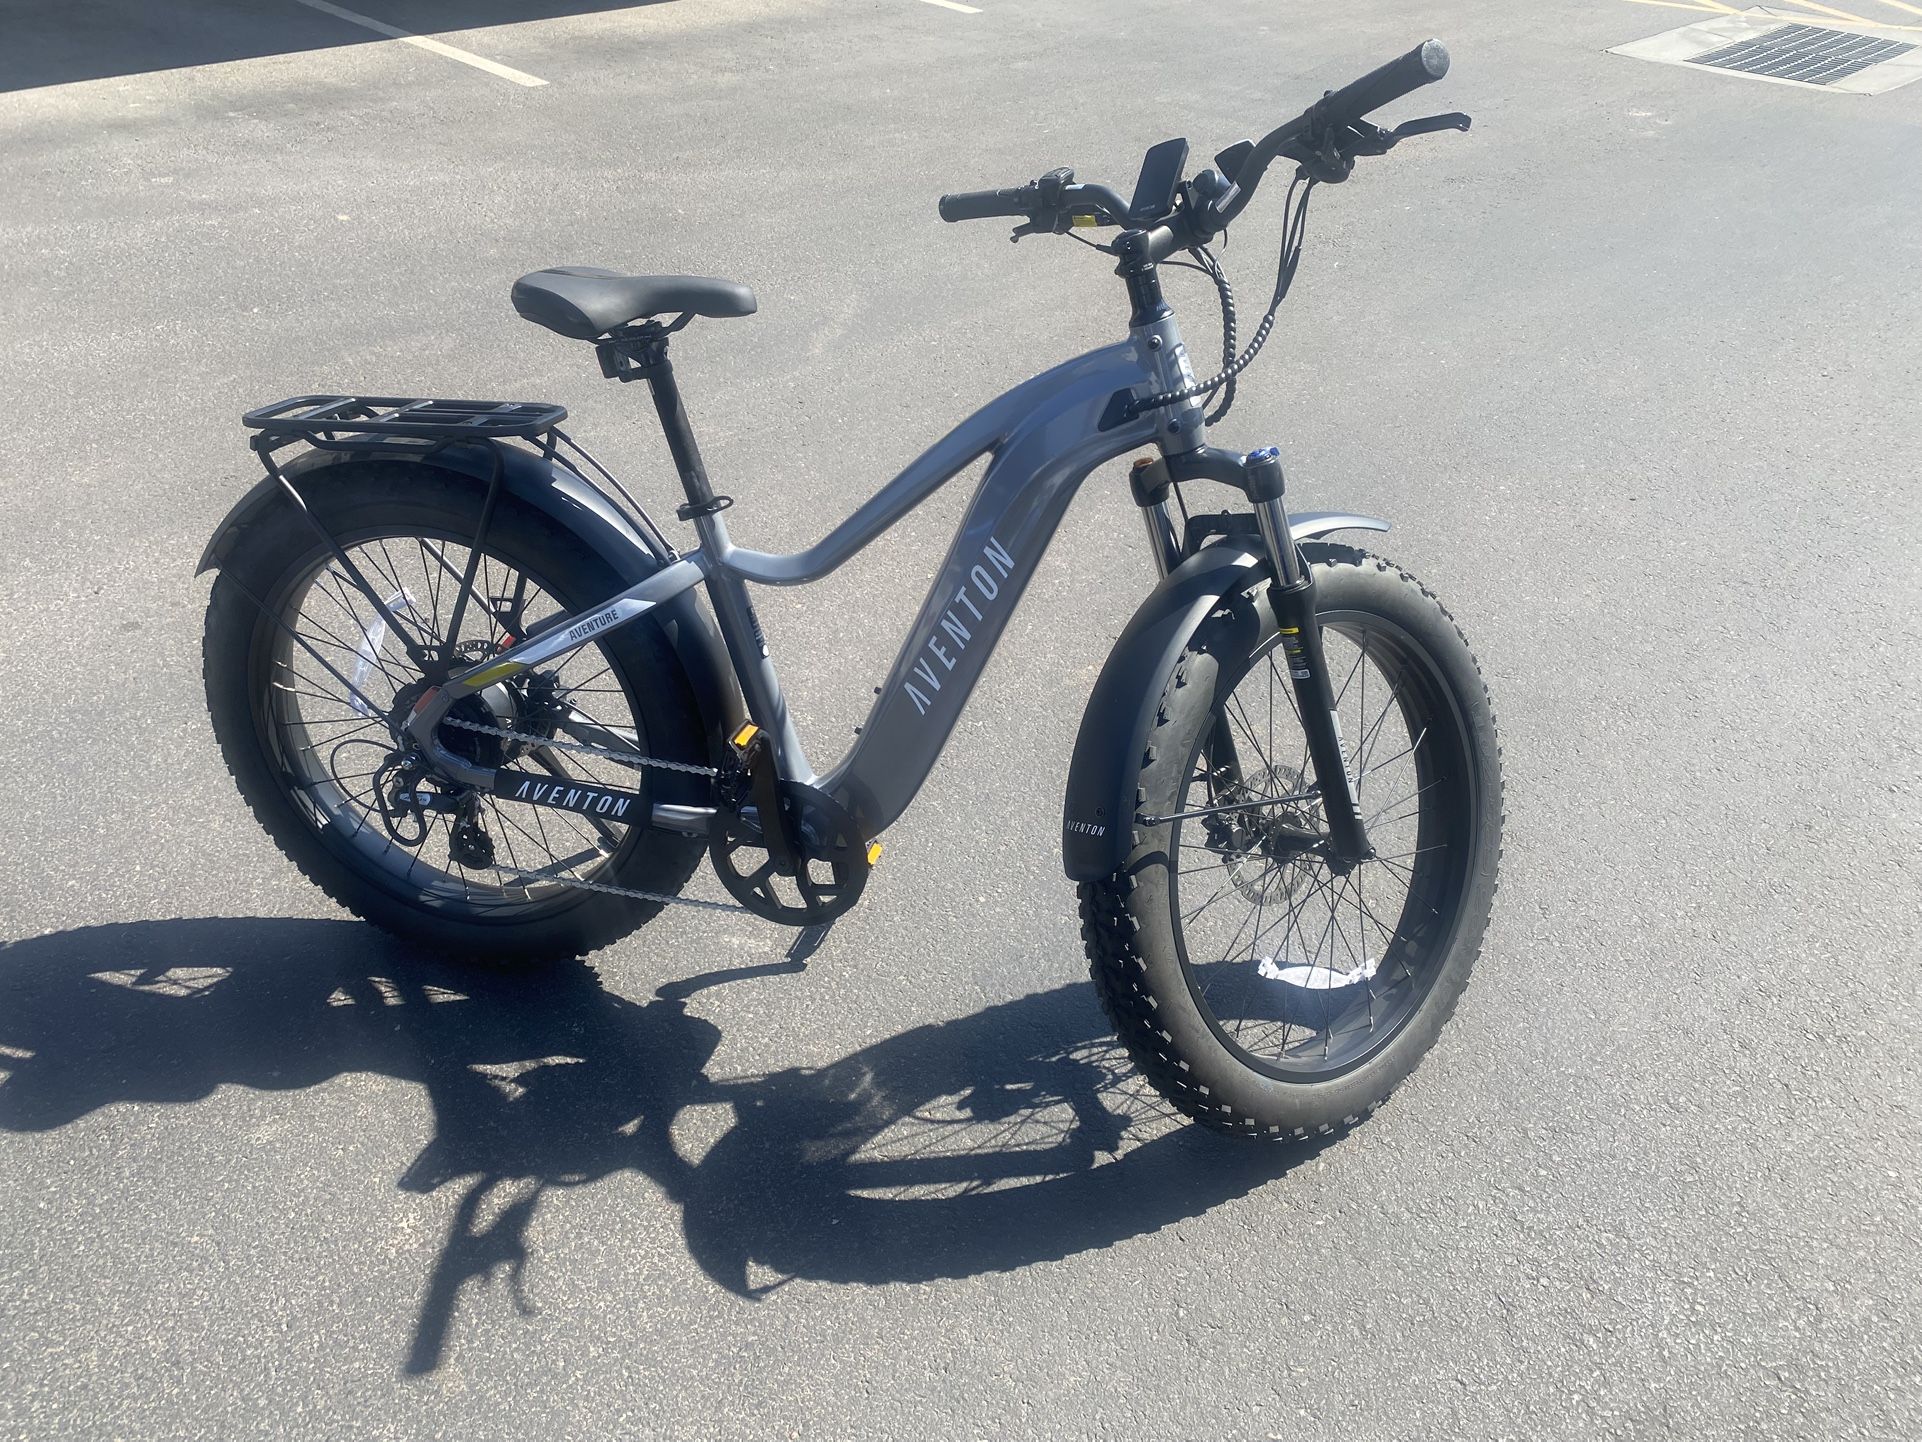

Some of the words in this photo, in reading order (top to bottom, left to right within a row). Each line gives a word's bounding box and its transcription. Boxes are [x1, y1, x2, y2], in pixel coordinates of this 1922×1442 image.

[569, 609, 619, 641] AVENTURE
[904, 536, 1015, 715] AVENTON
[515, 780, 631, 817] AVENTON
[1066, 820, 1106, 837] AVENTON
